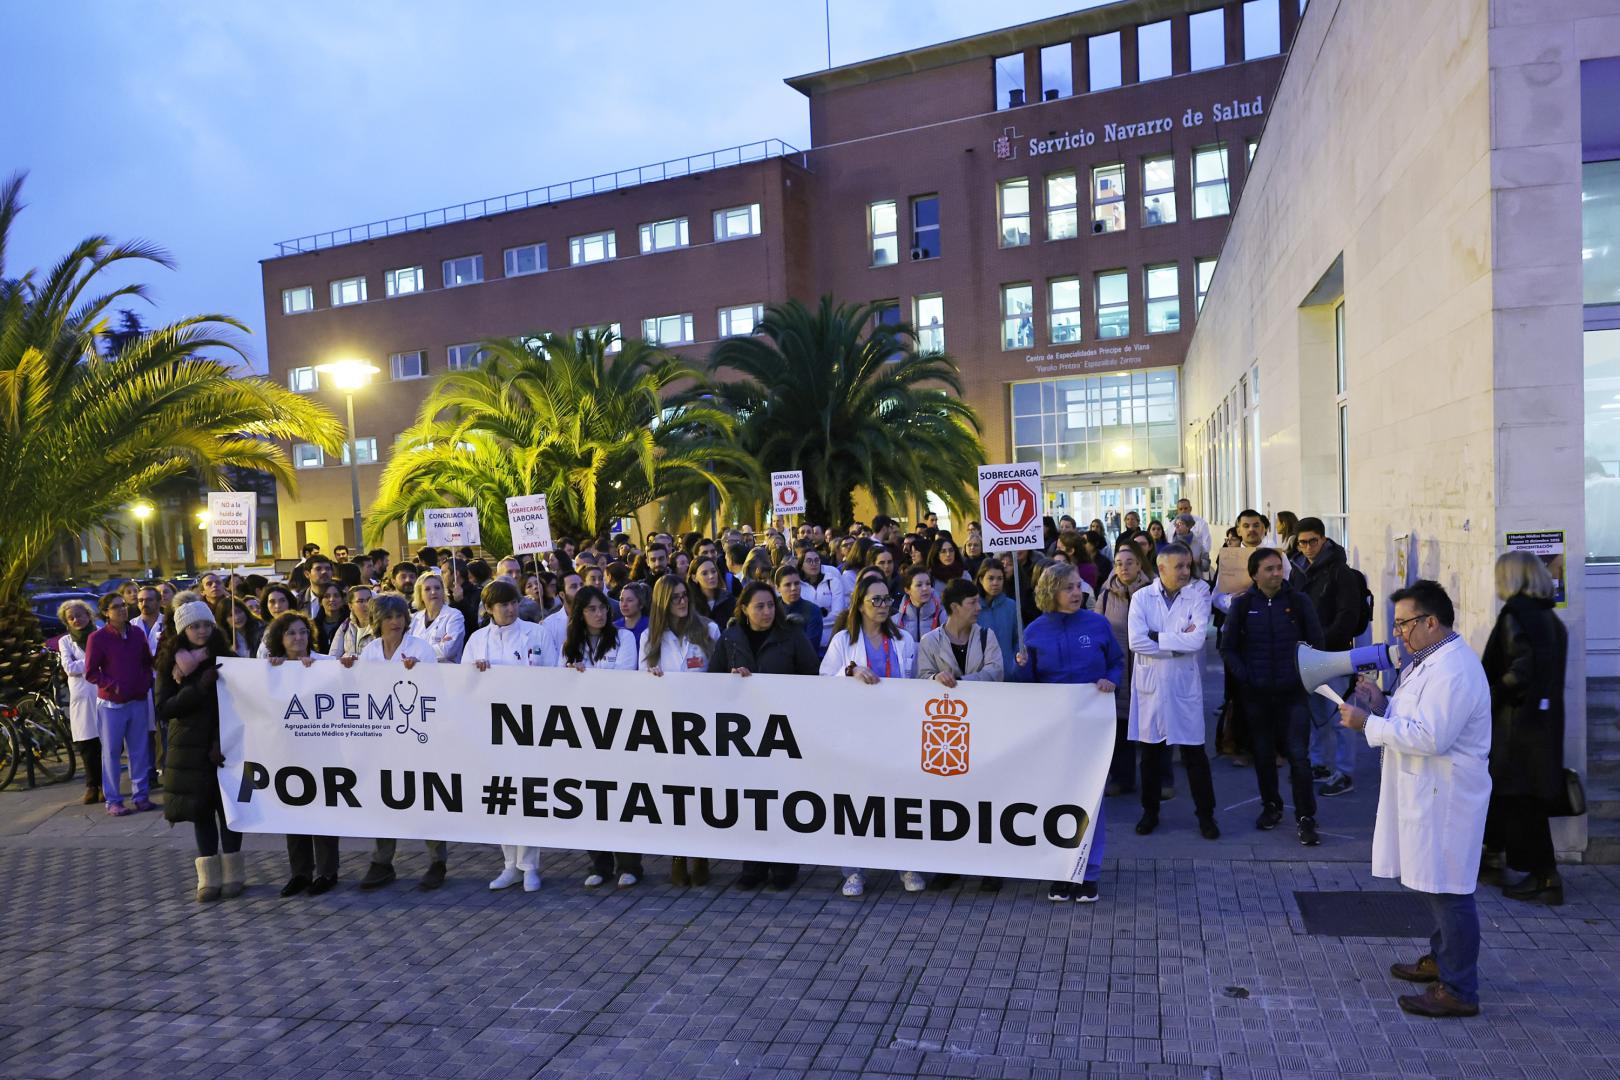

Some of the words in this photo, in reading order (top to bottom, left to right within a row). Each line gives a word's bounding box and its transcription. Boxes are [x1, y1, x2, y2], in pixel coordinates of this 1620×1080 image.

[1029, 128, 1095, 157] Servicio
[1104, 116, 1173, 143] Navarro
[1182, 109, 1203, 128] de
[1212, 96, 1264, 123] Salud
[1026, 354, 1045, 362] Centro
[1046, 353, 1054, 361] de
[1124, 344, 1132, 353] de
[1133, 343, 1150, 352] Viana
[980, 468, 1039, 480] SOBRECARGA
[509, 504, 546, 514] SOBRECARGA
[428, 511, 474, 520] CONCILIACIÓN
[512, 513, 544, 523] LABORAL
[989, 534, 1038, 547] AGENDAS
[284, 722, 321, 730] Agrupación
[330, 722, 371, 730] Profesionales
[491, 703, 802, 759] NAVARRA
[350, 730, 383, 738] Facultativo
[237, 761, 362, 808] POR
[380, 769, 463, 813] UN
[482, 776, 1089, 849] #ESTATUTOMEDICO
